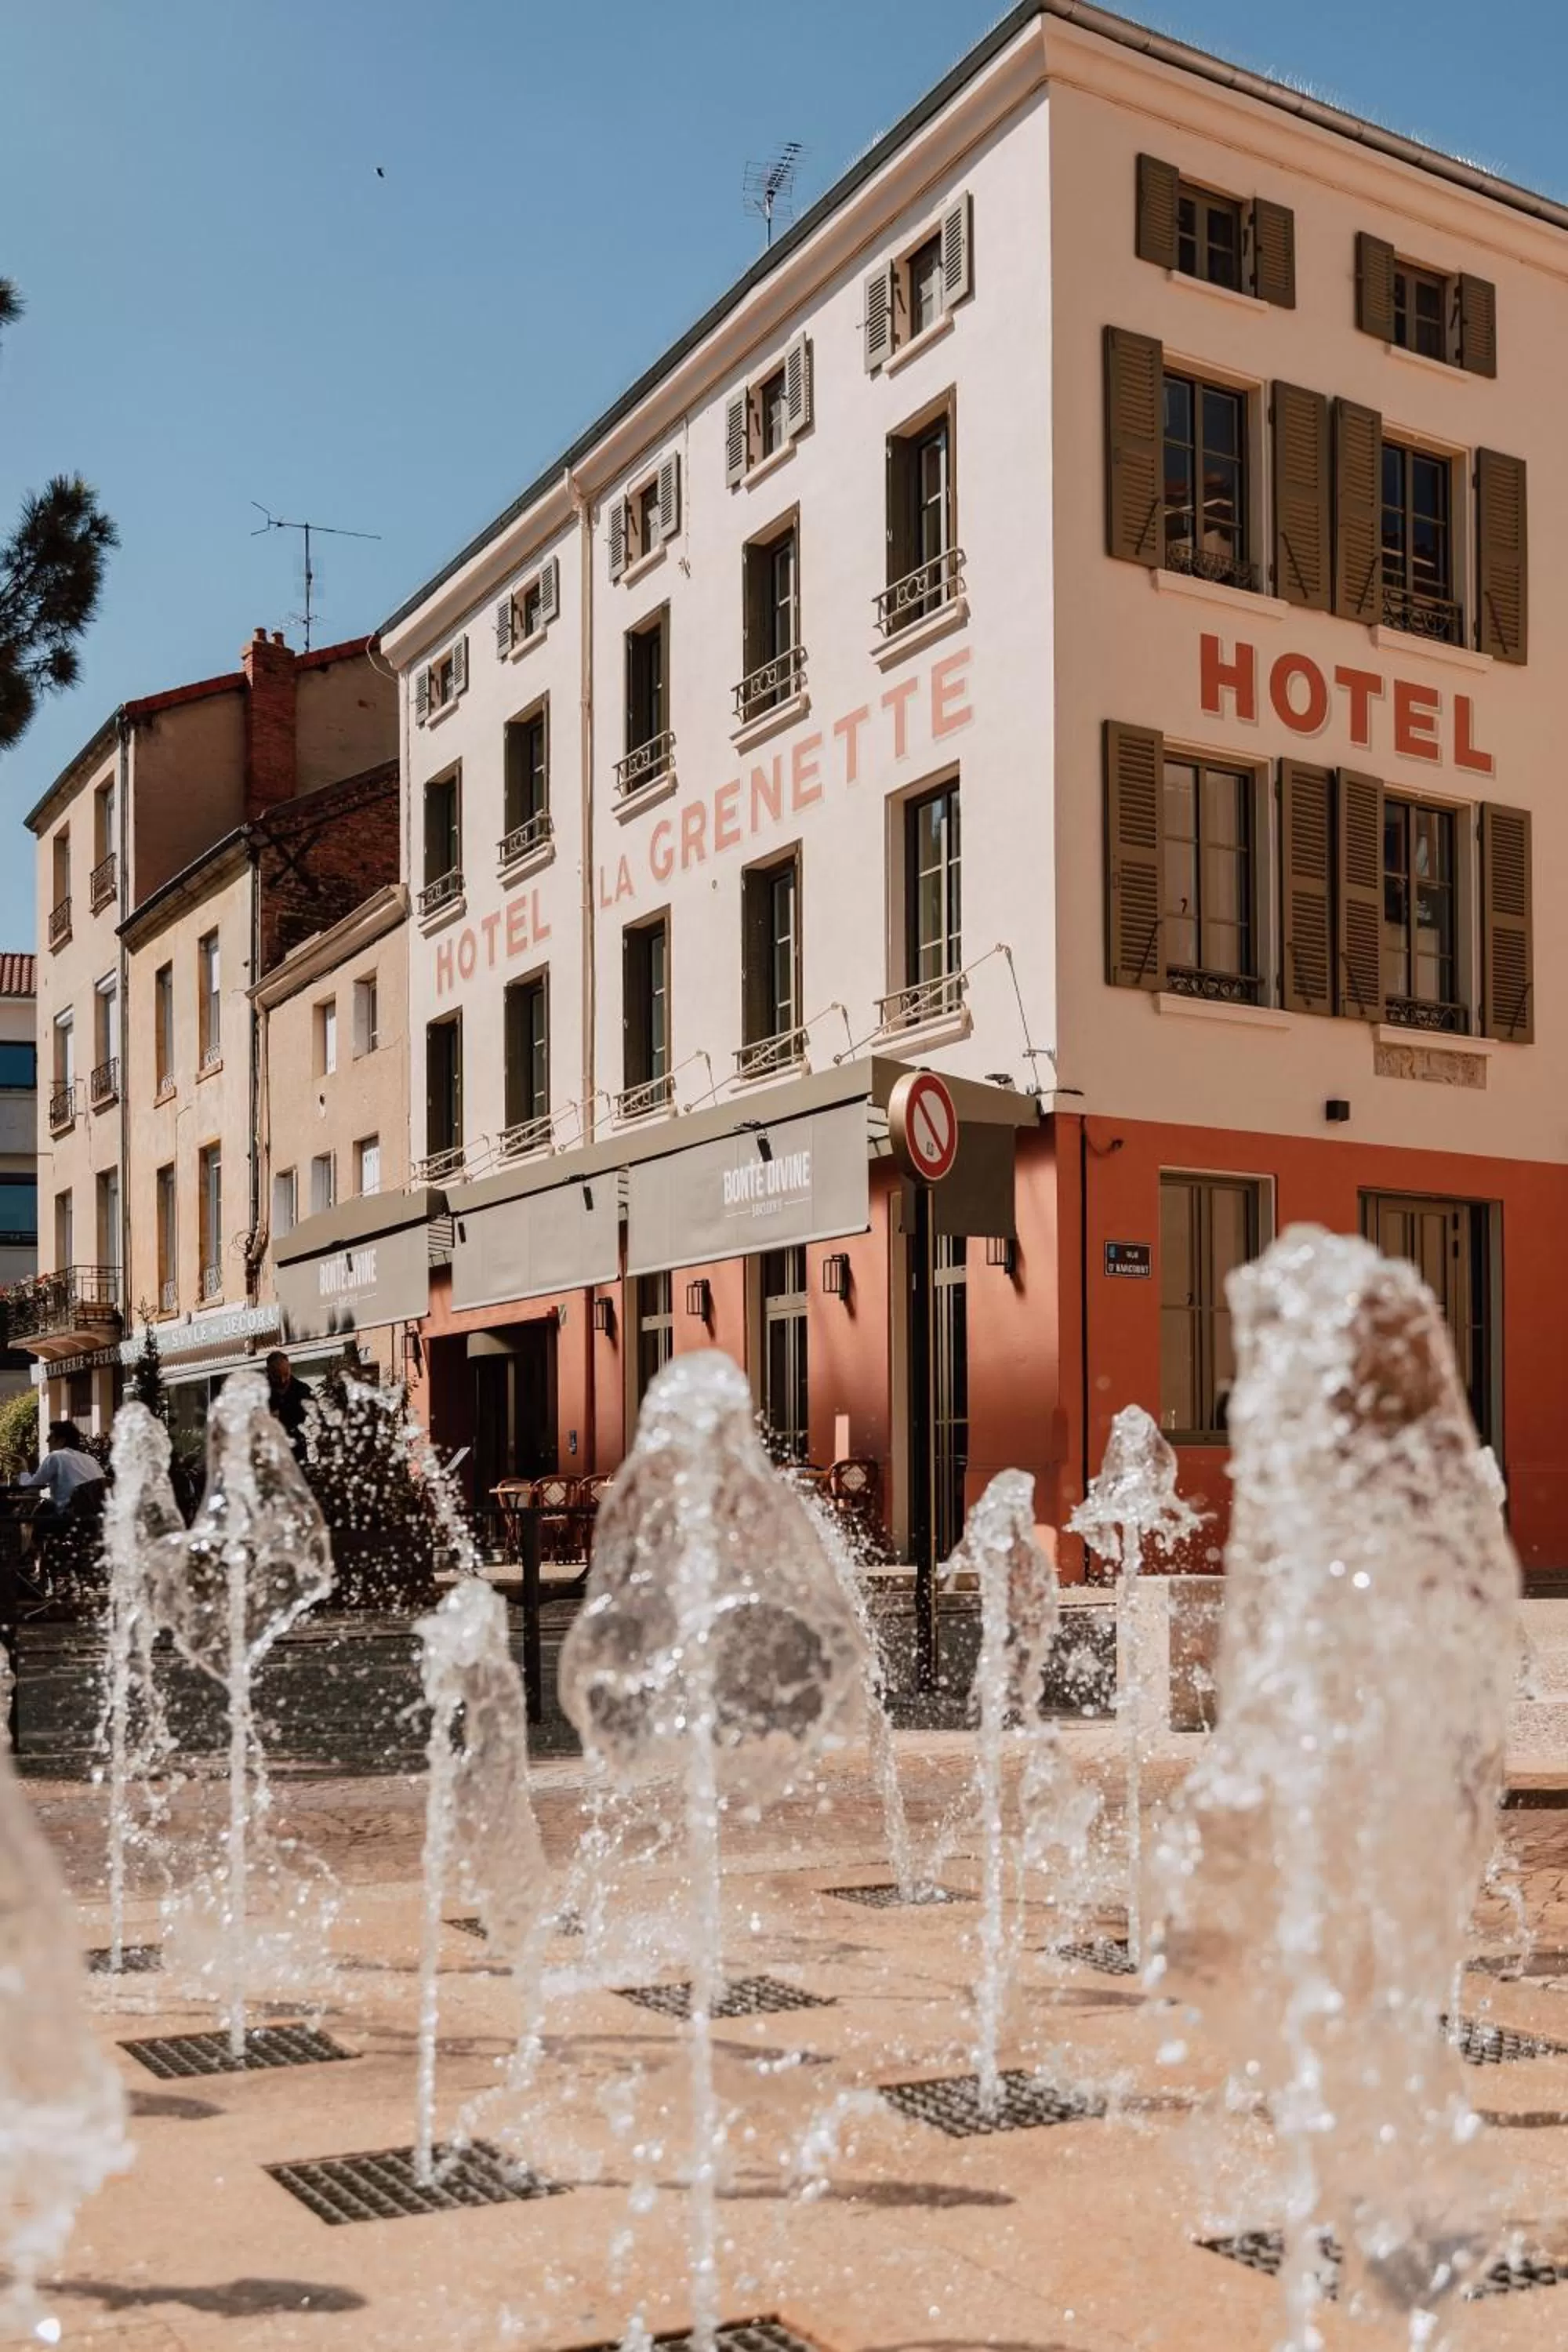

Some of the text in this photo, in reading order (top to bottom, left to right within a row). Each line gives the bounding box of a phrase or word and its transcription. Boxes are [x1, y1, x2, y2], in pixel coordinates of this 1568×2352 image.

[1200, 633, 1494, 775] HOTEL
[436, 646, 975, 996] HOTEL LA GRENETTE
[767, 1151, 810, 1196] DIVINE
[171, 1325, 208, 1348] STYLE
[224, 1305, 278, 1334] DECORA
